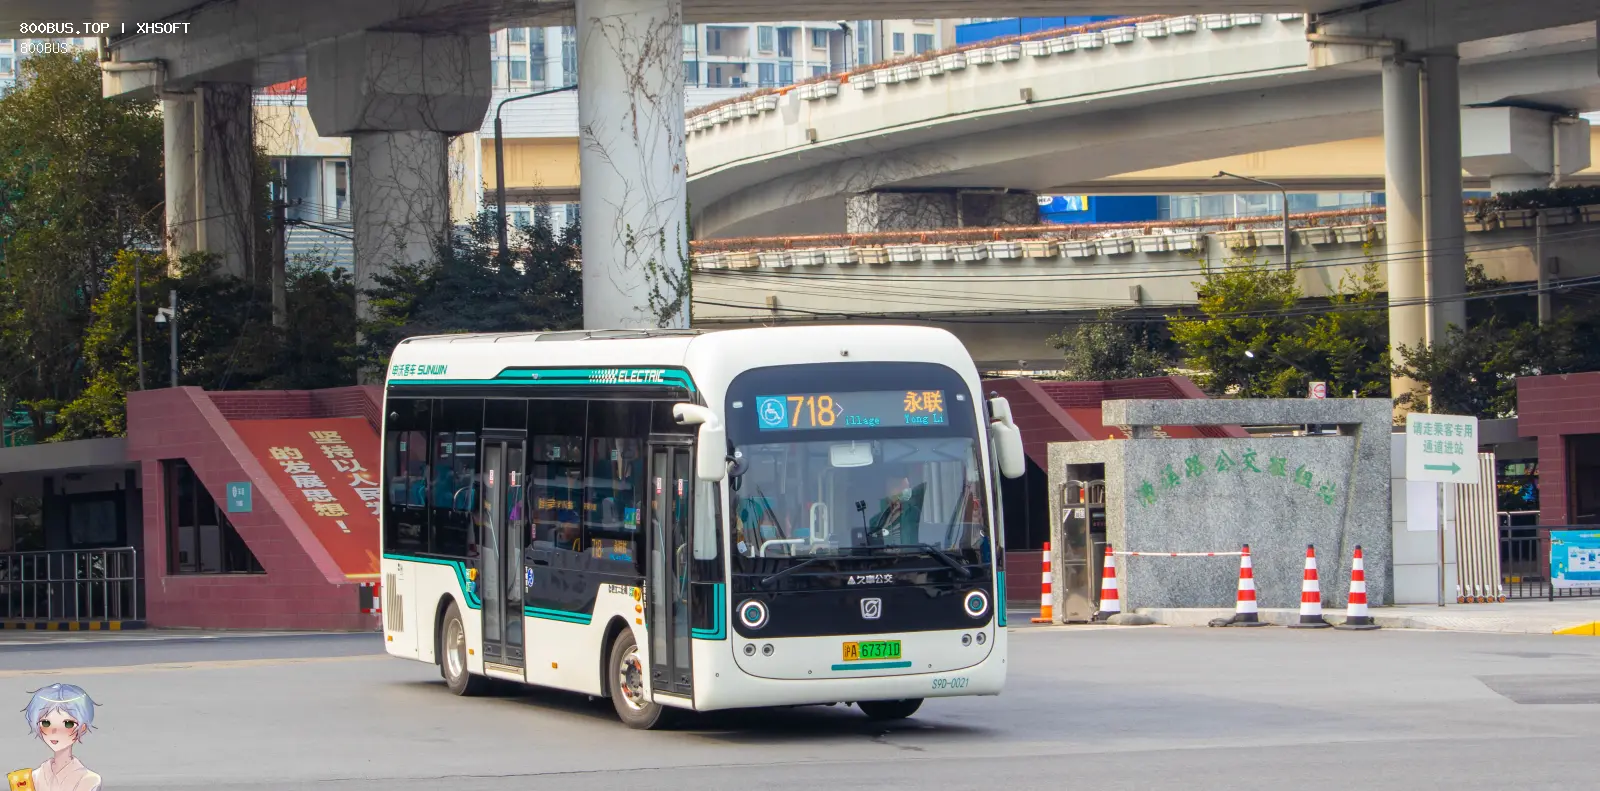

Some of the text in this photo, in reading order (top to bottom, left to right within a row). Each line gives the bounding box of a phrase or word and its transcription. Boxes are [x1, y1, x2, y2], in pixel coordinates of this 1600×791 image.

[417, 364, 448, 375] SUNWIN
[618, 369, 665, 383] ELECTRIC
[903, 390, 944, 413] 永联
[787, 395, 836, 427] 718
[904, 414, 930, 424] Yong
[1412, 421, 1473, 438] 请走乘客专用
[1422, 440, 1464, 455] 通道进站
[308, 430, 381, 523] 坚持以人民
[931, 677, 969, 690] S9D-0021
